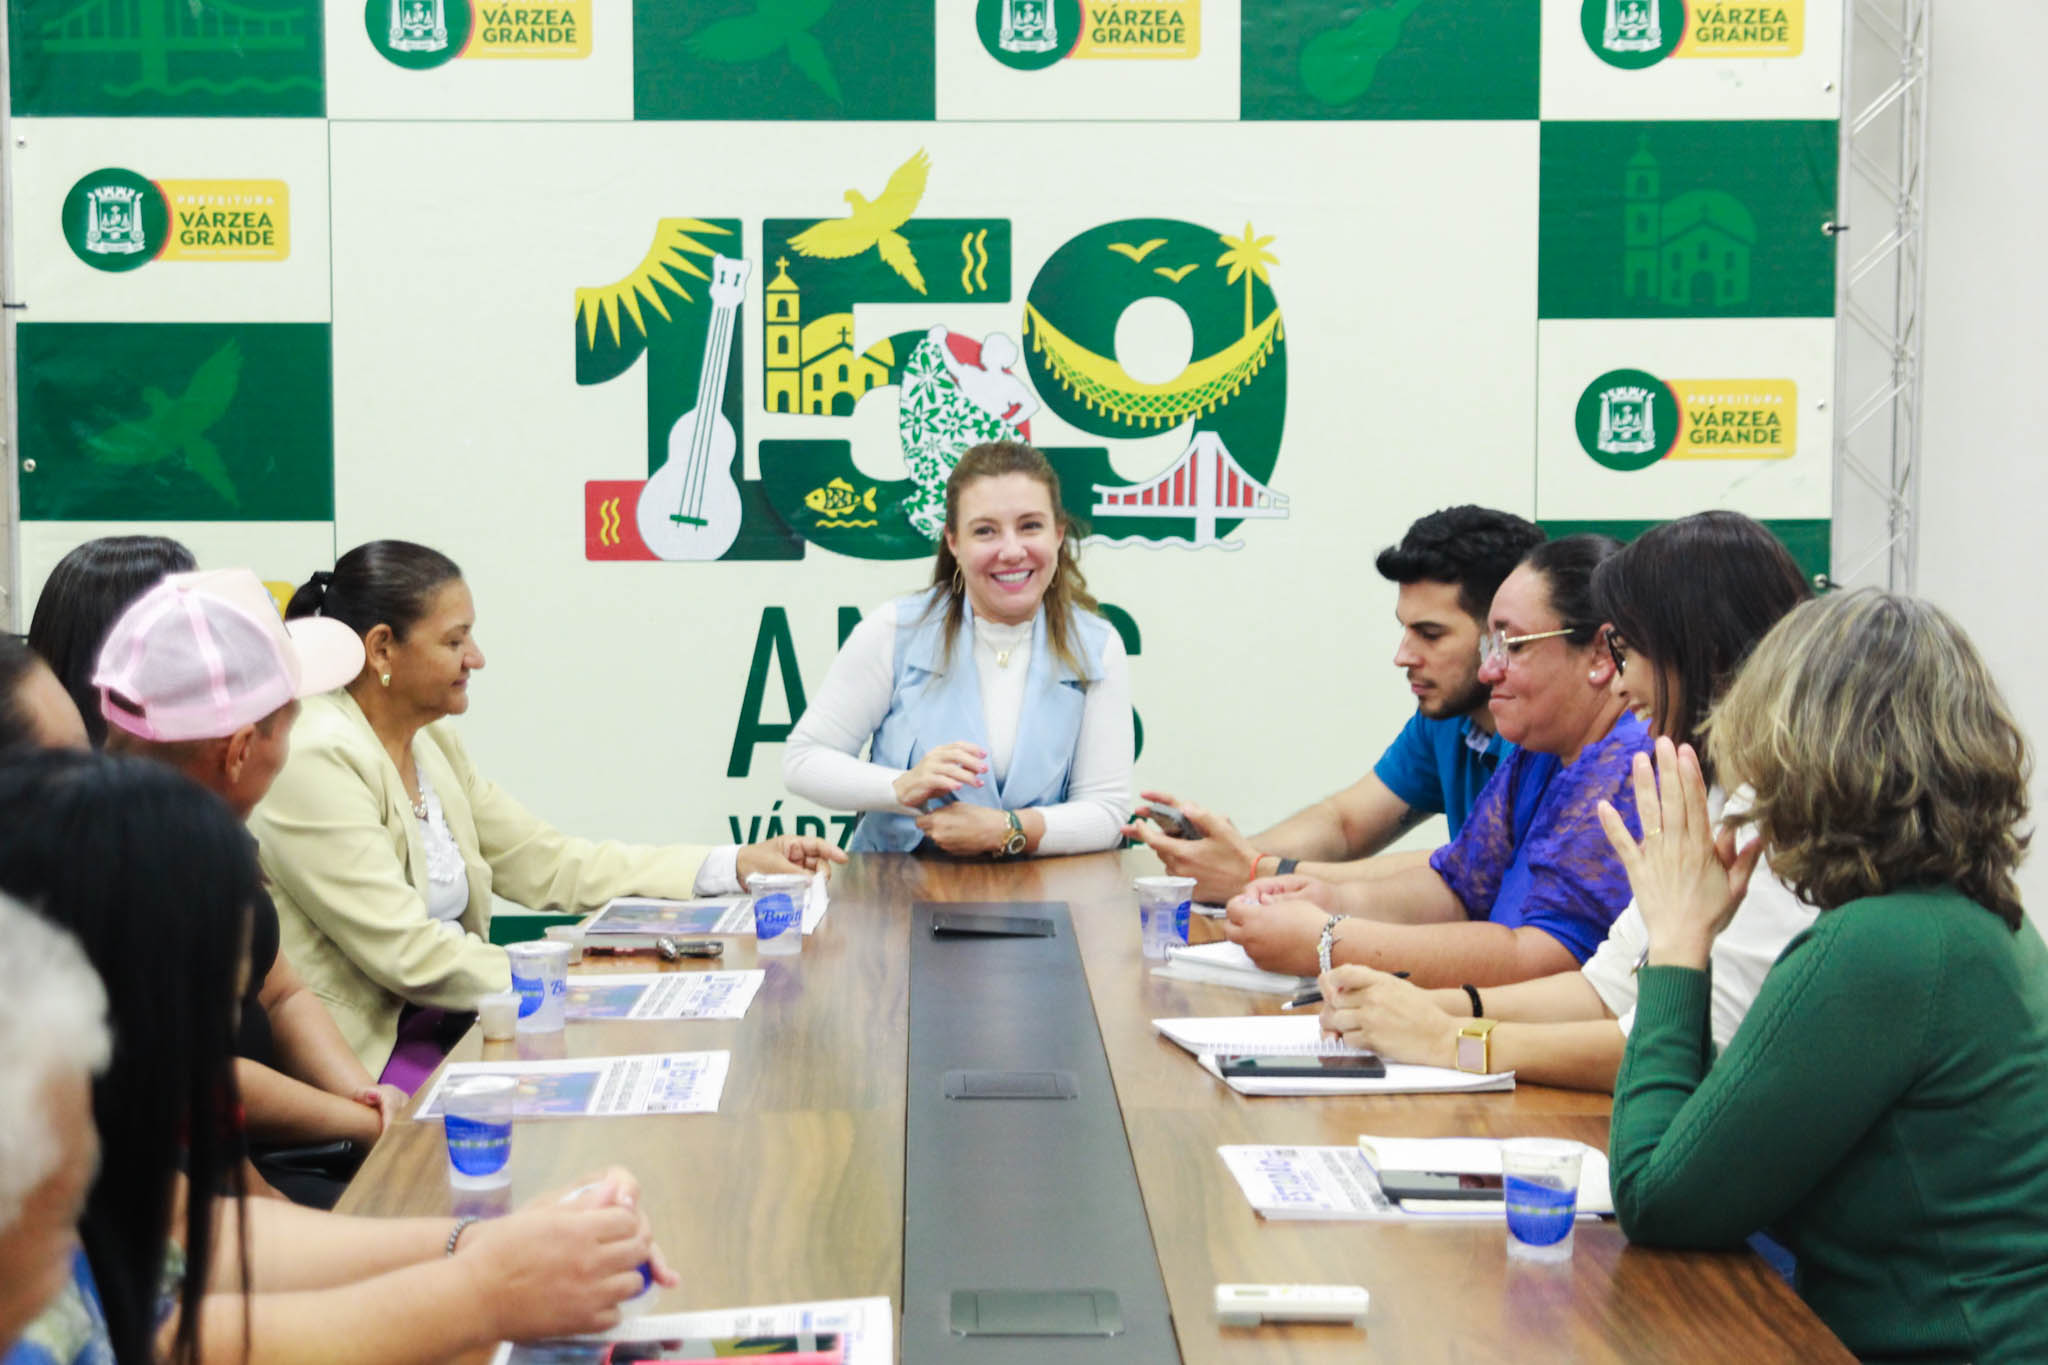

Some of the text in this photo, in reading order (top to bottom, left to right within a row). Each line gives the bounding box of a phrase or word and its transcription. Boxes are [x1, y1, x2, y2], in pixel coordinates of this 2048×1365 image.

[482, 2, 576, 26] VÁRZEA
[1092, 3, 1185, 26] VÁRZEA
[1696, 2, 1788, 25] VÁRZEA
[482, 27, 577, 44] GRANDE
[1092, 27, 1186, 44] GRANDE
[1696, 26, 1788, 43] GRANDE
[179, 206, 273, 229] VÁRZEA
[180, 230, 275, 246] GRANDE
[1689, 404, 1782, 428] VÁRZEA
[1689, 428, 1783, 445] GRANDE
